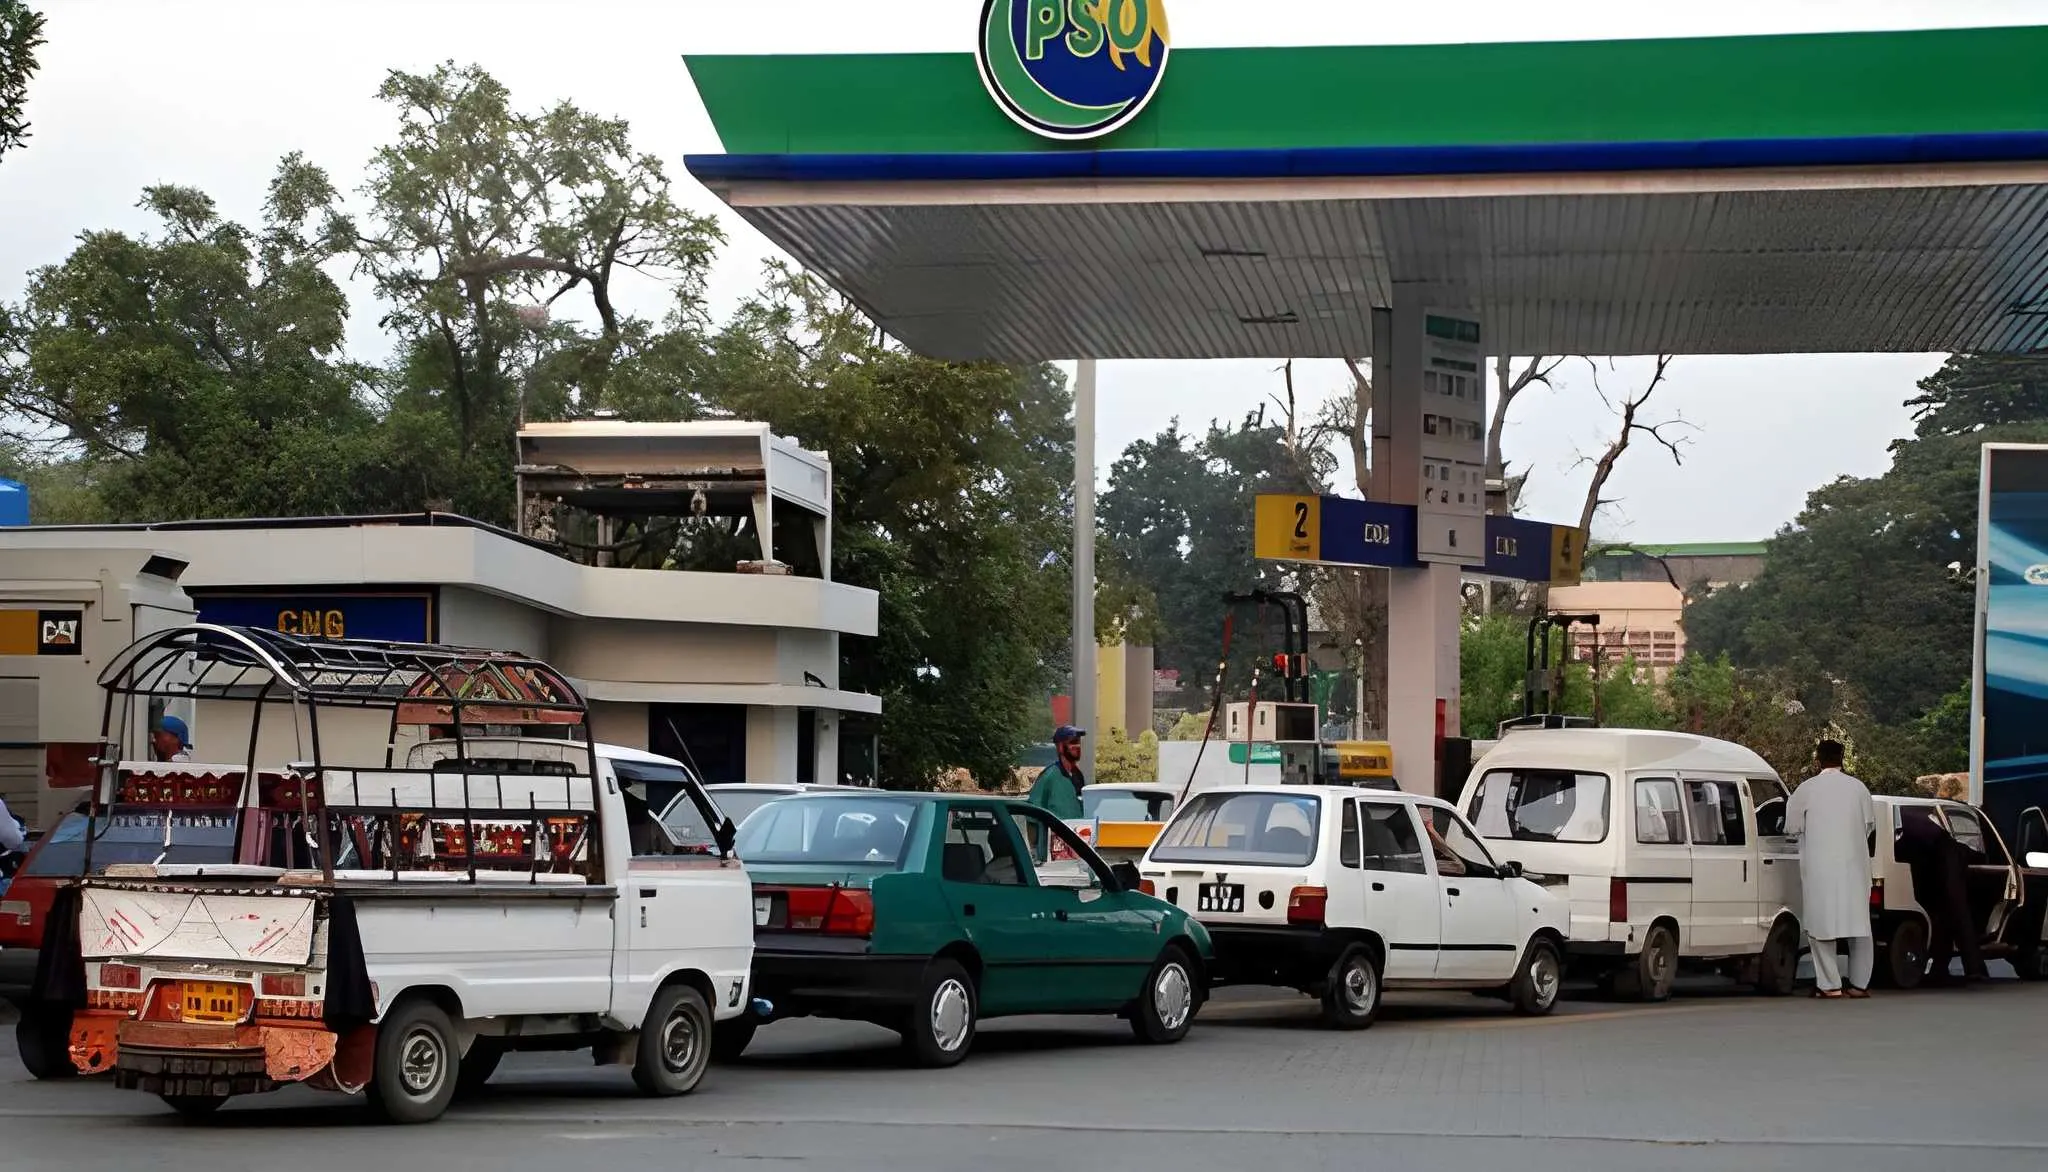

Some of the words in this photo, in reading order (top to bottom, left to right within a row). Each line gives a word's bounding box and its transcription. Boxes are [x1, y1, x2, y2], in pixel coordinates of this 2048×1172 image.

[1026, 0, 1149, 60] PSO
[1295, 502, 1308, 538] 2
[278, 610, 343, 637] CNG
